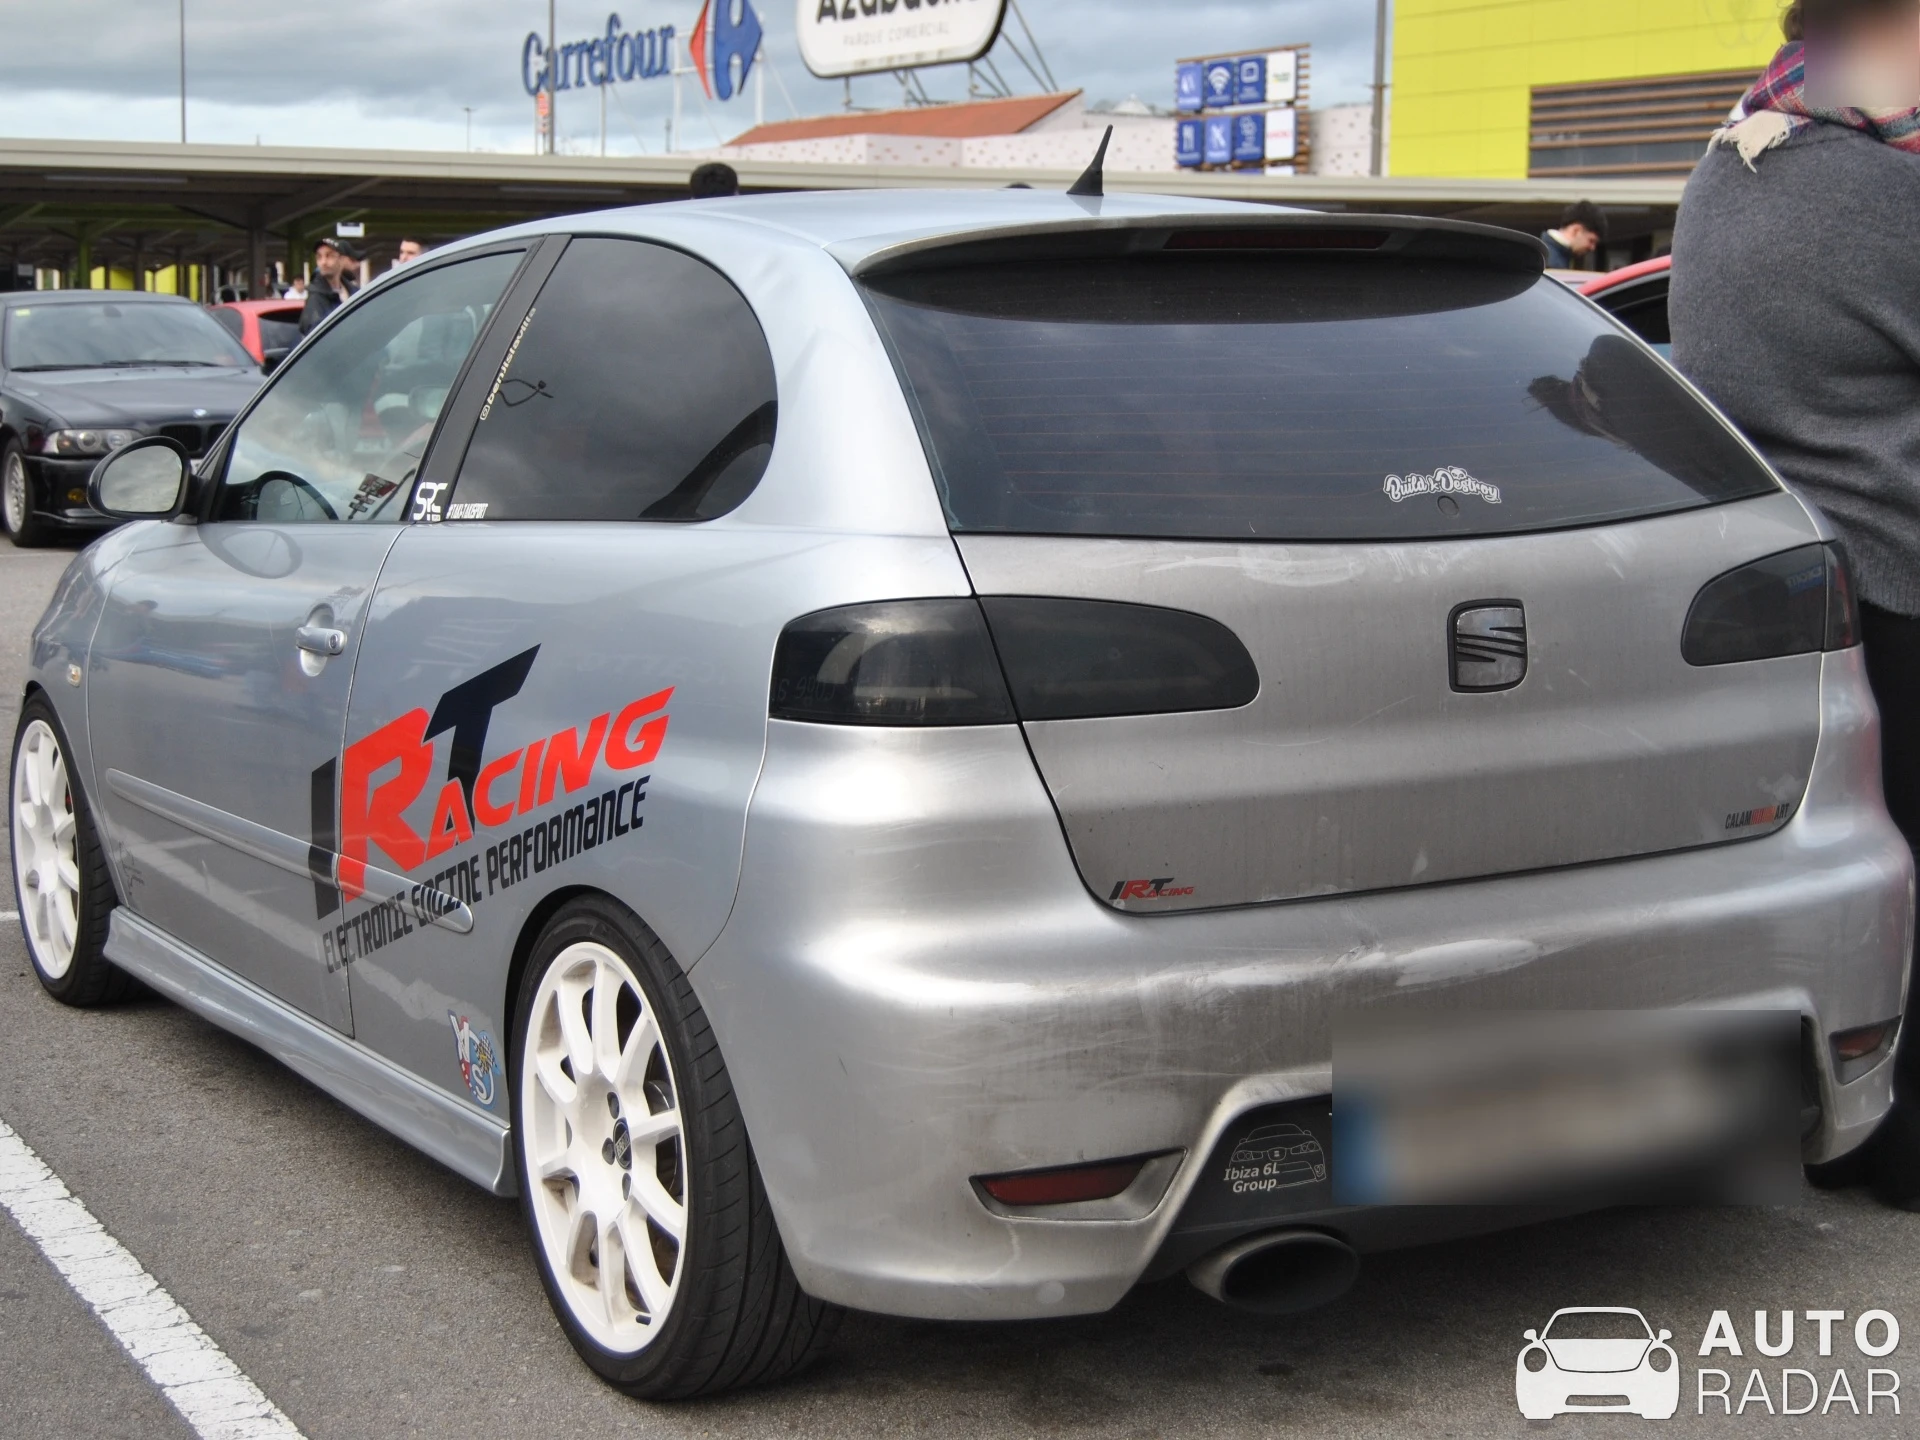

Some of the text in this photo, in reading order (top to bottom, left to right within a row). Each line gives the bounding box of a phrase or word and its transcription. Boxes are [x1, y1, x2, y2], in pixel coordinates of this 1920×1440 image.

[843, 22, 951, 46] PARQUE COMERCIAL
[522, 12, 676, 97] Carrefour
[1385, 475, 1427, 501] Build
[1436, 468, 1501, 503] Destroy
[486, 775, 652, 896] PERFORMANCE
[1223, 1162, 1280, 1181] Ibiza 6L
[1232, 1178, 1277, 1193] Group
